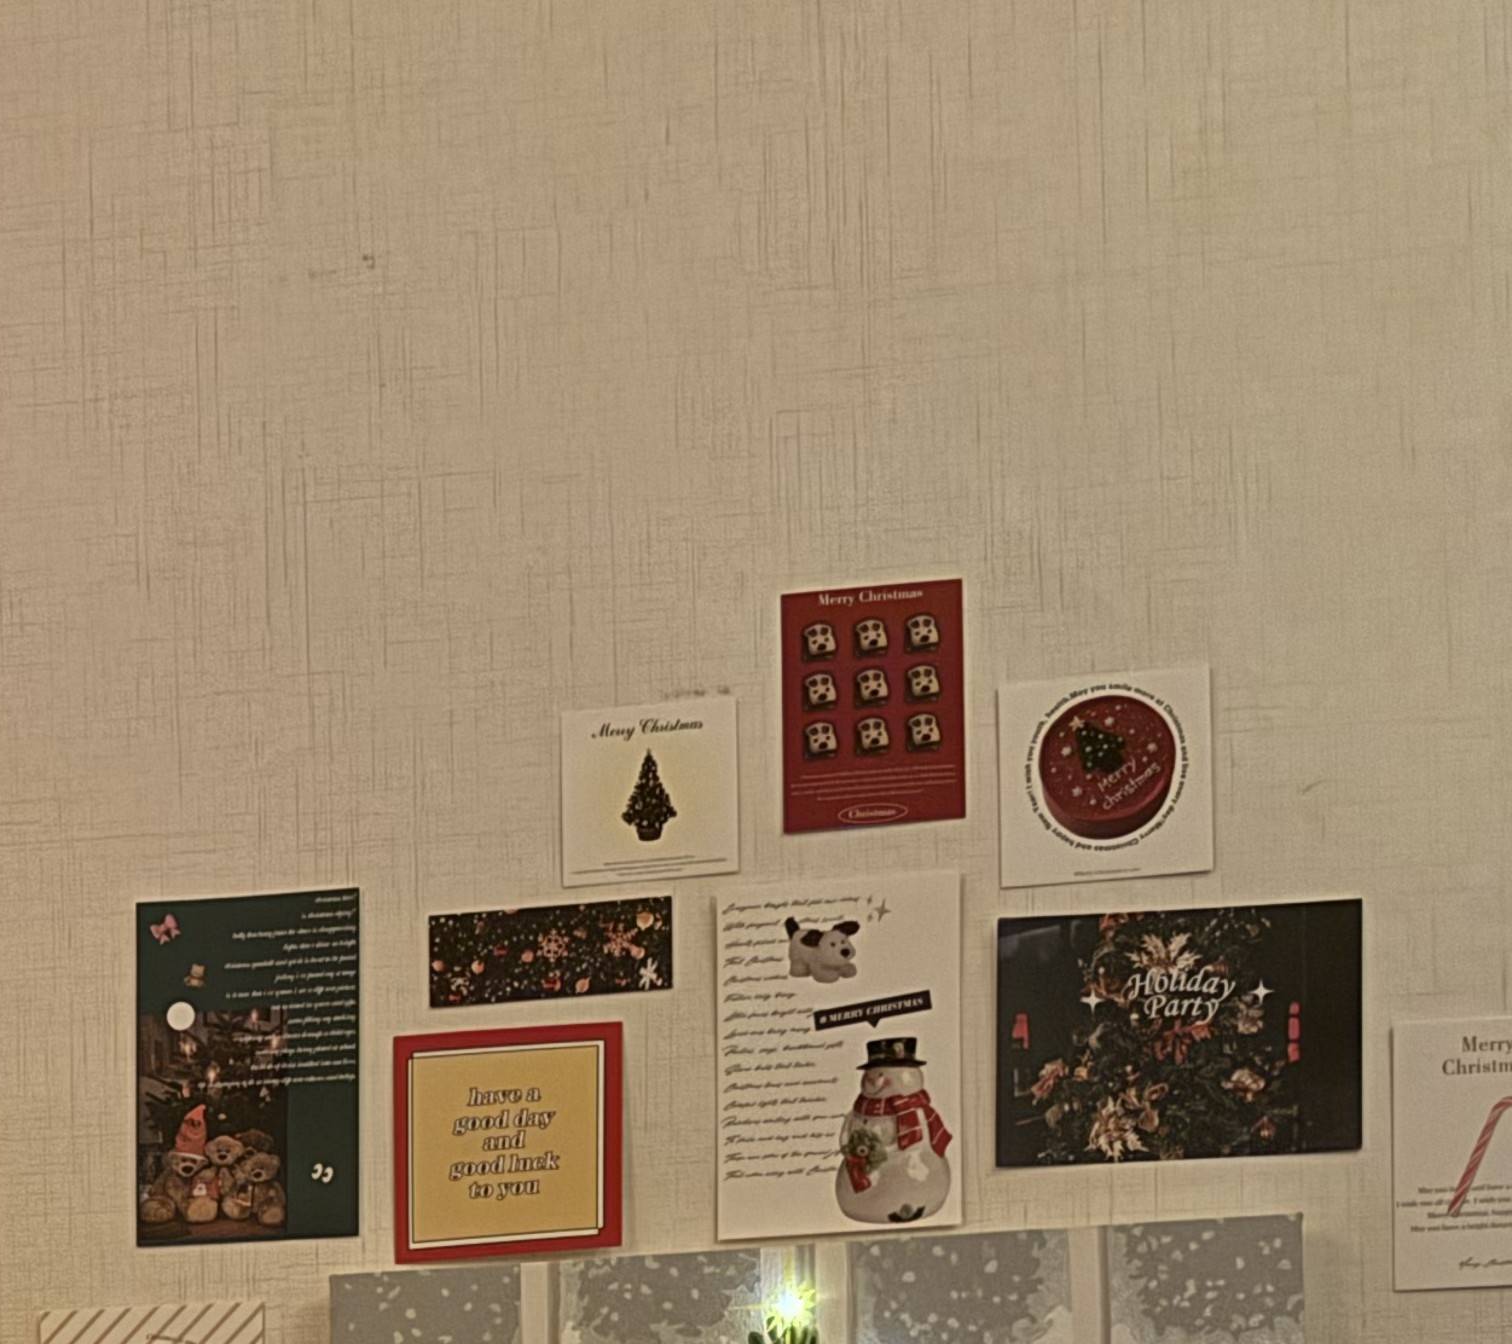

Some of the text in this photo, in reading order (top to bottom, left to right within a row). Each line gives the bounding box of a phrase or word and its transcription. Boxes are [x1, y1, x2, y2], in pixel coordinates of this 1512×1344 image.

[818, 588, 924, 607] Merry Christmas
[638, 718, 704, 734] Christmas
[1125, 969, 1237, 1002] Holiday
[829, 1008, 864, 1022] MERRY
[866, 996, 924, 1016] CHRISTMAS
[1143, 995, 1221, 1027] Party
[1462, 1035, 1512, 1055] Merry
[467, 1087, 541, 1106] have a
[453, 1109, 556, 1135] good day
[482, 1131, 525, 1151] and
[449, 1151, 560, 1180] good luck
[469, 1179, 540, 1200] to you
